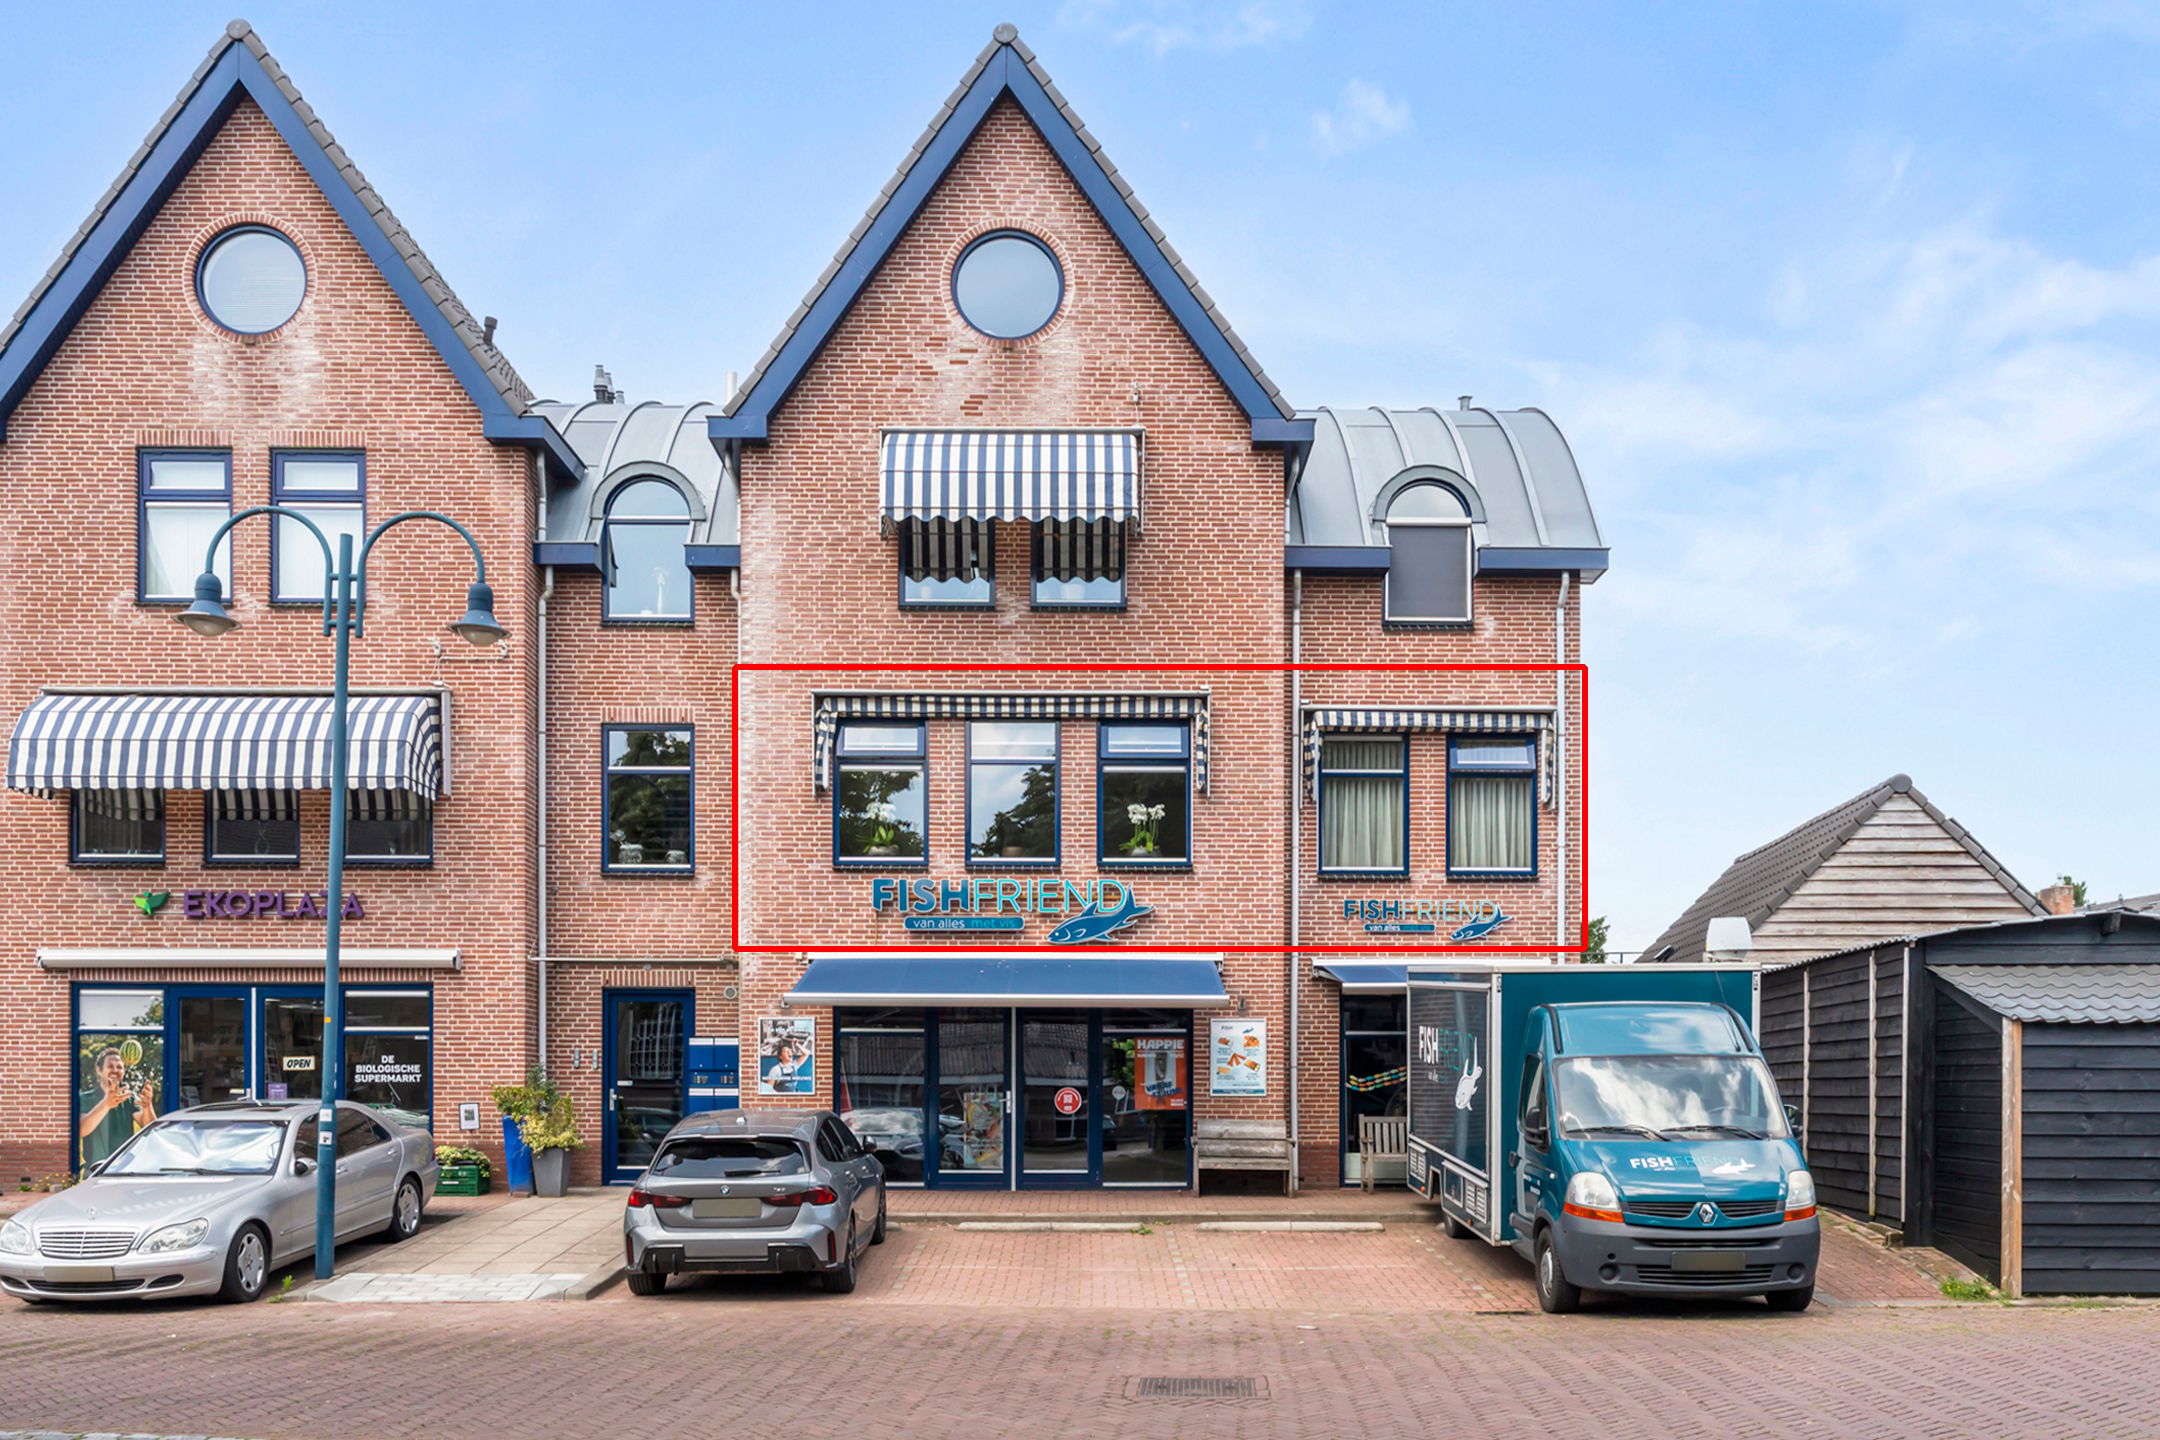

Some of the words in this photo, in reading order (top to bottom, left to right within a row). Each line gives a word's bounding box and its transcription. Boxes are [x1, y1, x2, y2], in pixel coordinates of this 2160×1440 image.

[872, 878, 1127, 913] FISHFRIEND
[1343, 899, 1499, 922] FISHFRIEND
[913, 919, 935, 929] van
[938, 917, 965, 929] alles
[971, 918, 996, 929] met
[1000, 917, 1016, 929] vis
[1137, 1039, 1185, 1049] HAPPIE
[286, 1058, 311, 1068] OPEN
[381, 1055, 395, 1064] DE
[355, 1064, 421, 1073] BIOLOGISCHE
[354, 1074, 422, 1083] SUPERMARKT
